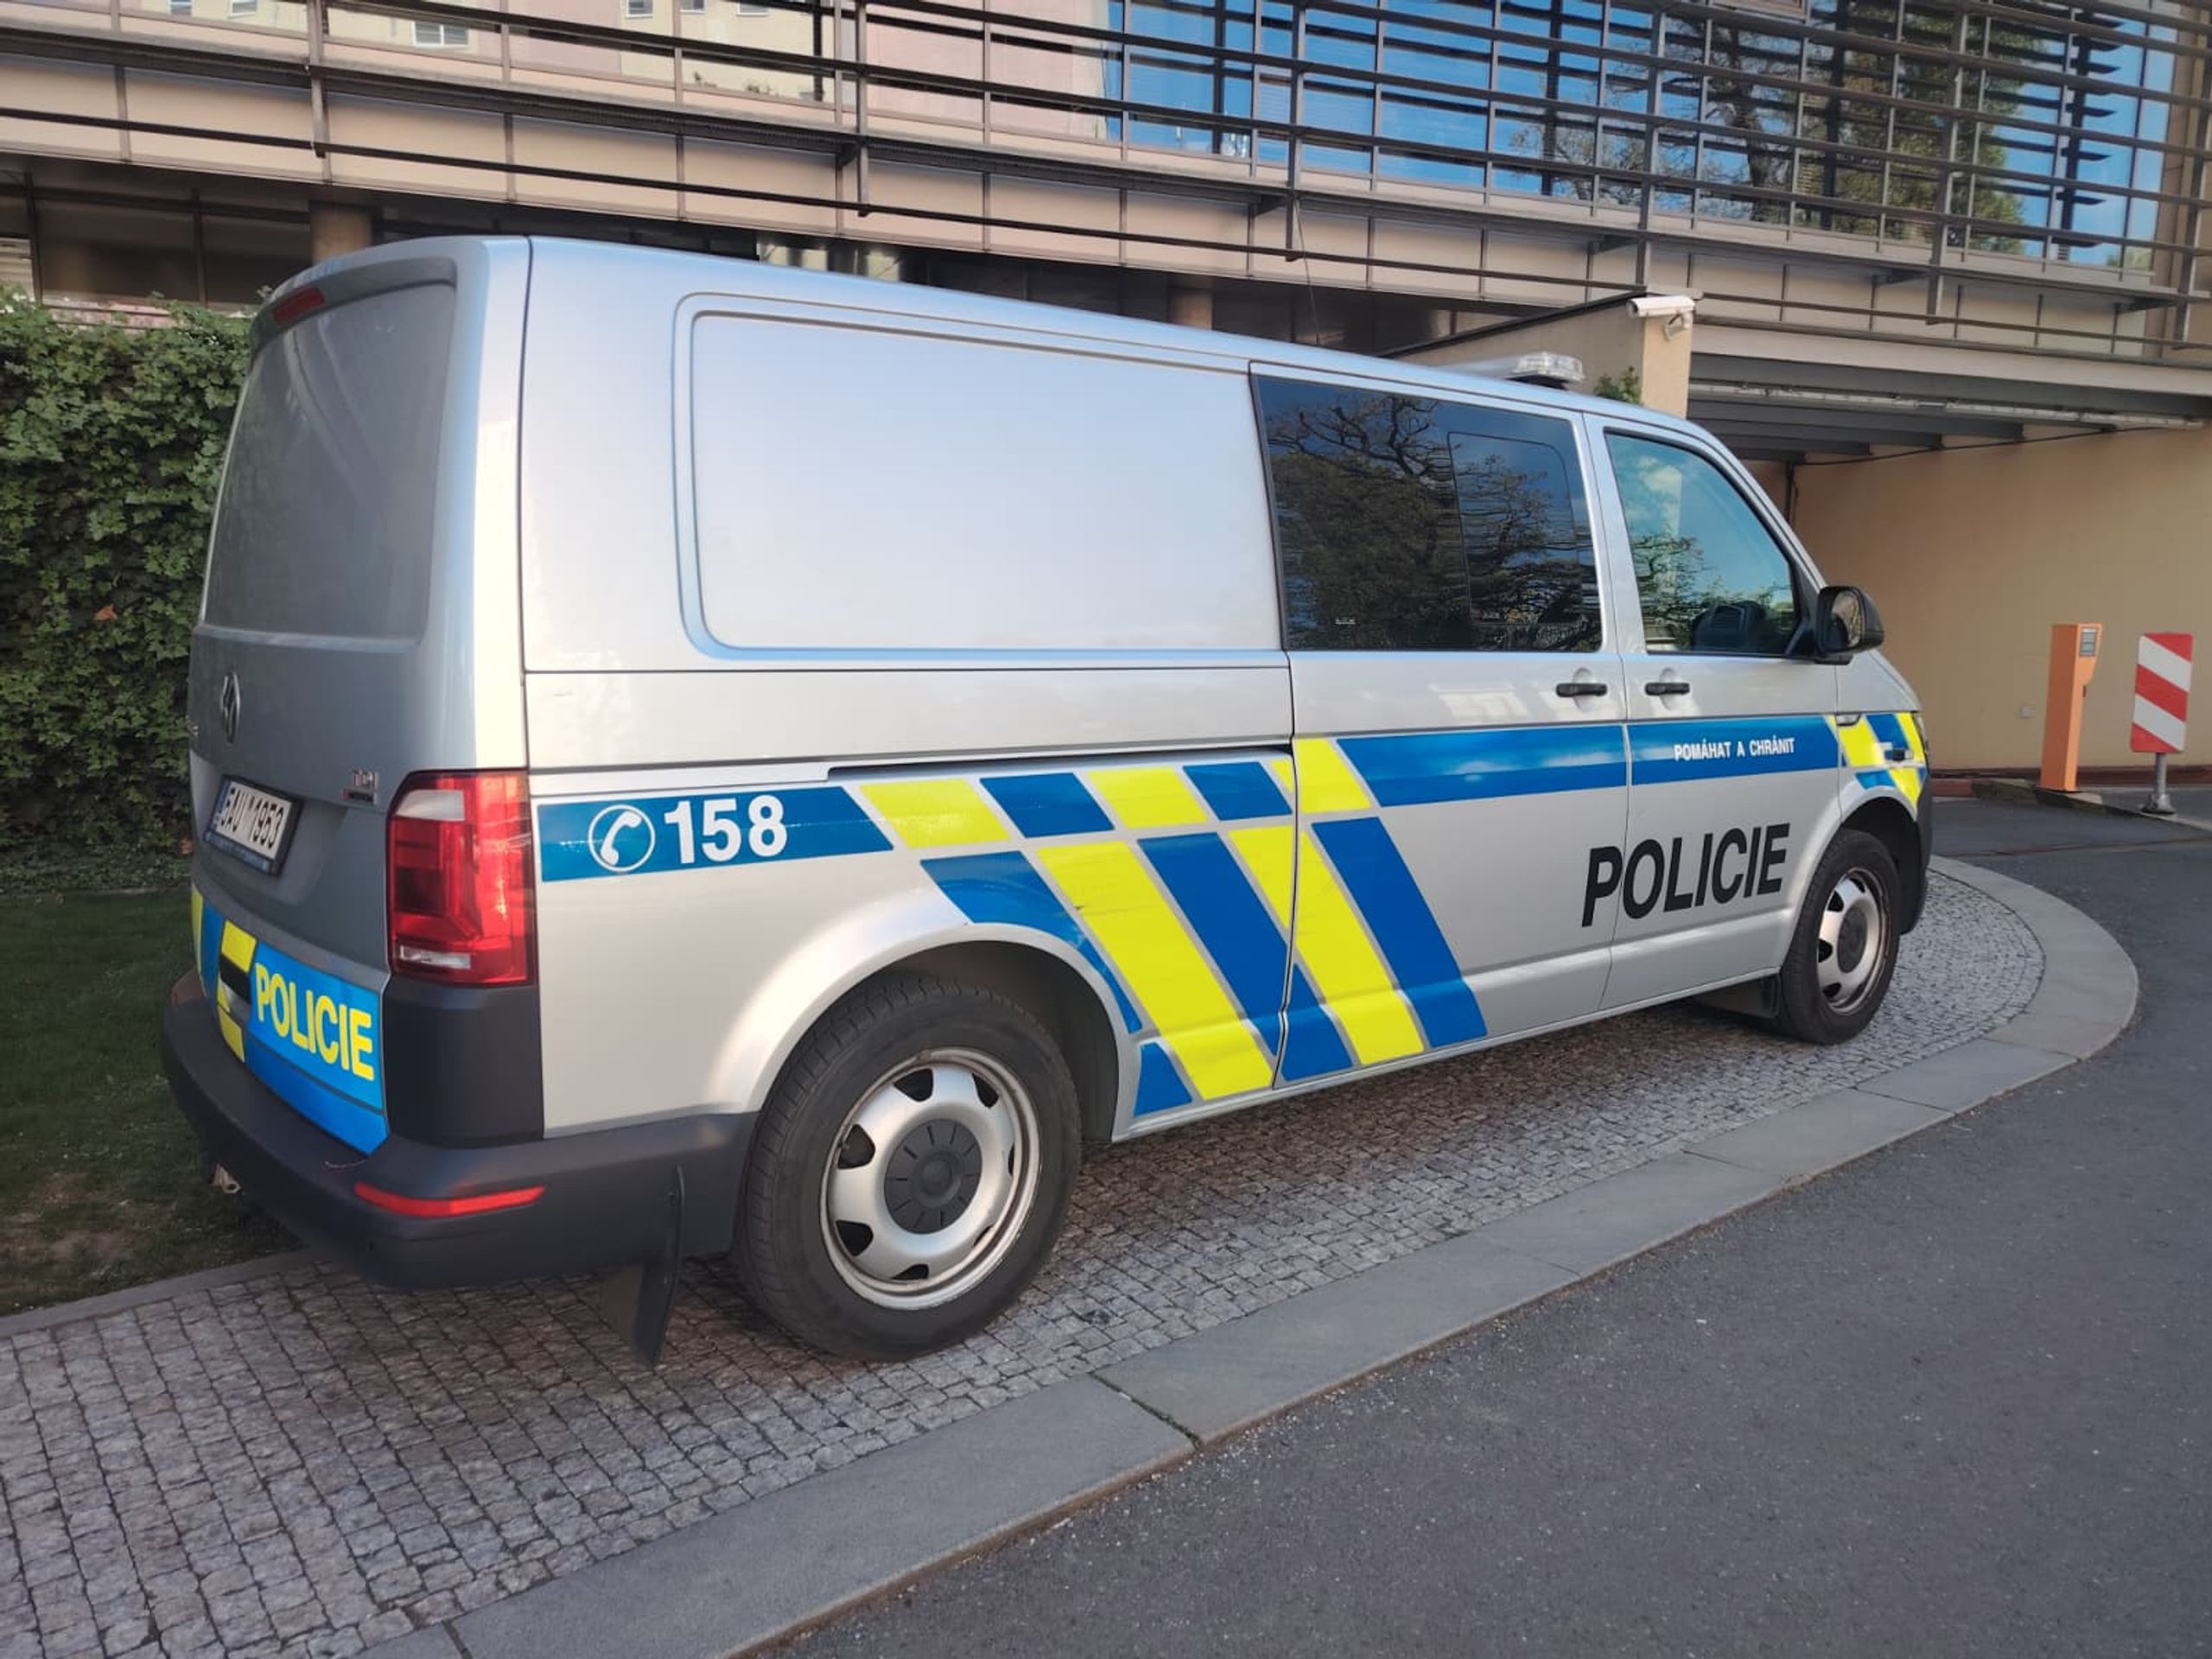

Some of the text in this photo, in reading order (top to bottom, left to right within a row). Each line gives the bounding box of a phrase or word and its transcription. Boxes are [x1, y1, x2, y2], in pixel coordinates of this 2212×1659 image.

[1674, 734, 1796, 761] POMÁHAT A CHRÁNIT
[663, 794, 788, 864] 158
[1581, 823, 1790, 927] POLICIE
[255, 962, 375, 1082] POLICIE
